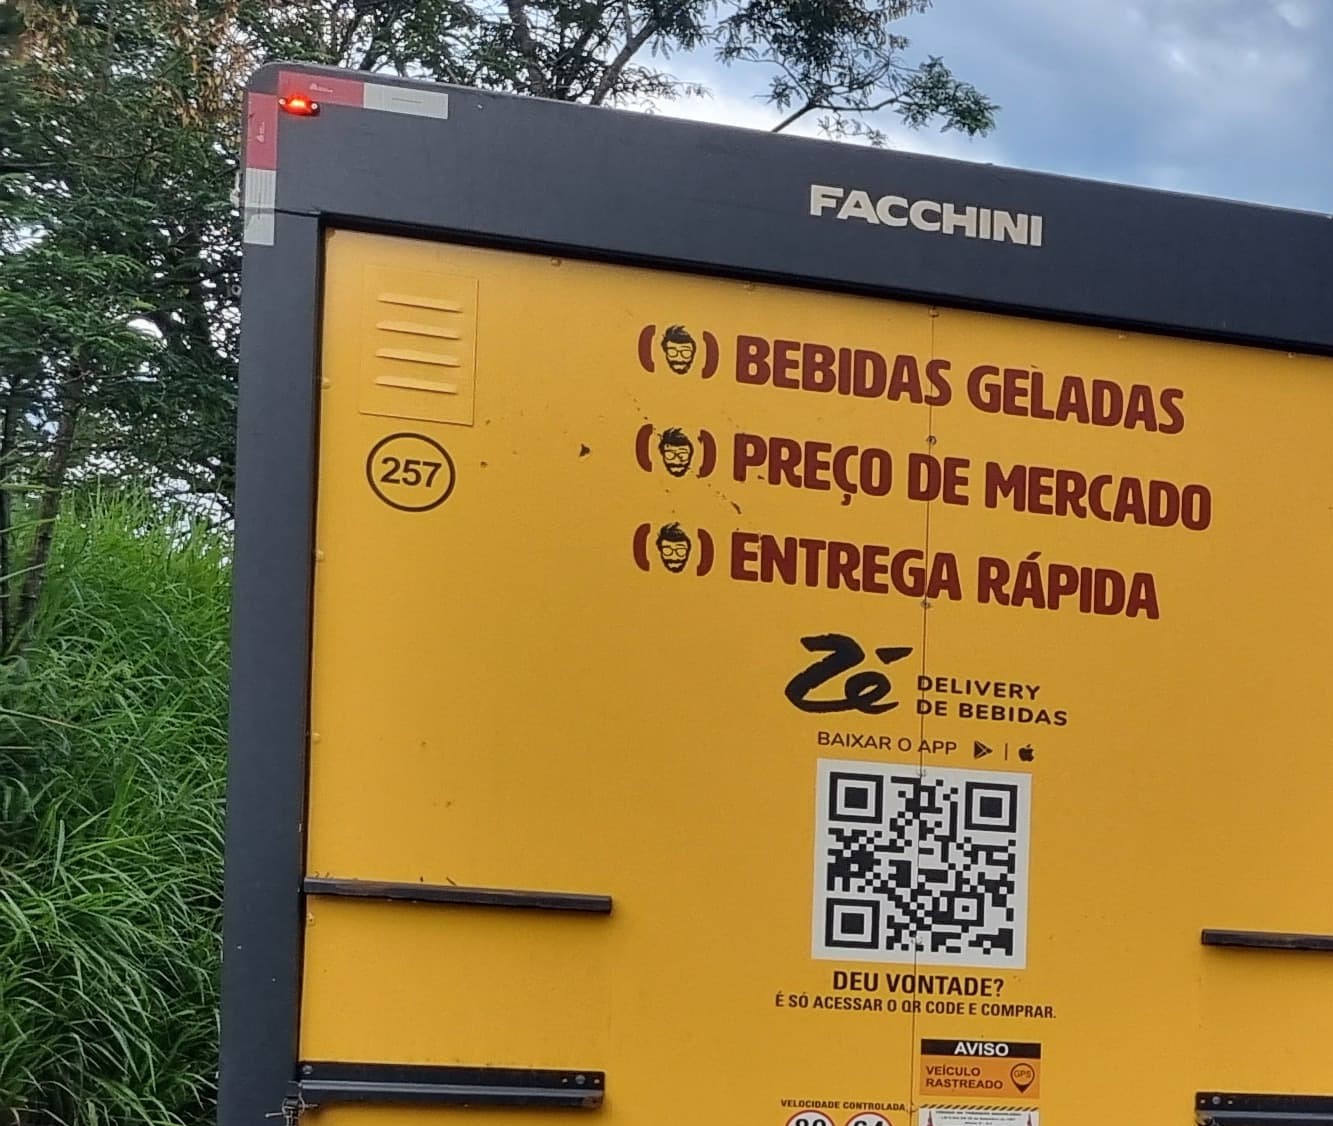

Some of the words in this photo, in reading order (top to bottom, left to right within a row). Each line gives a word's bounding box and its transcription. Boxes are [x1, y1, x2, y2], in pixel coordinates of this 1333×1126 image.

[809, 183, 1044, 248] FACCHINI
[735, 335, 952, 406] BEBIDAS
[966, 364, 1185, 435] GELADAS
[380, 455, 442, 489] 257
[733, 432, 893, 506] PREÇO
[907, 452, 970, 506] DE
[984, 461, 1213, 532] MERCADO
[730, 531, 962, 602] ENTREGA
[977, 551, 1161, 620] RÁPIDA
[784, 632, 914, 715] Zé
[917, 676, 1041, 701] DELIVERY
[916, 699, 948, 717] DE
[959, 704, 1068, 727] BEBIDAS
[817, 731, 892, 751] BAIXAR
[897, 737, 912, 752] O
[917, 740, 957, 755] APP
[833, 971, 879, 992] DEU
[886, 973, 1004, 998] VONTADE?
[776, 992, 785, 1008] É
[788, 991, 809, 1009] SÓ
[813, 995, 883, 1012] ACESSAR
[887, 998, 898, 1012] O
[902, 998, 921, 1014] QR
[926, 1000, 965, 1015] CODE
[969, 1003, 977, 1016] E
[981, 1003, 1057, 1019] COMPRAR.
[954, 1041, 1009, 1057] AVISO
[925, 1064, 981, 1077] VEÍCULO
[1013, 1069, 1032, 1079] GPS
[925, 1078, 1004, 1091] RASTREADO
[780, 1099, 841, 1110] VELOCIDADE
